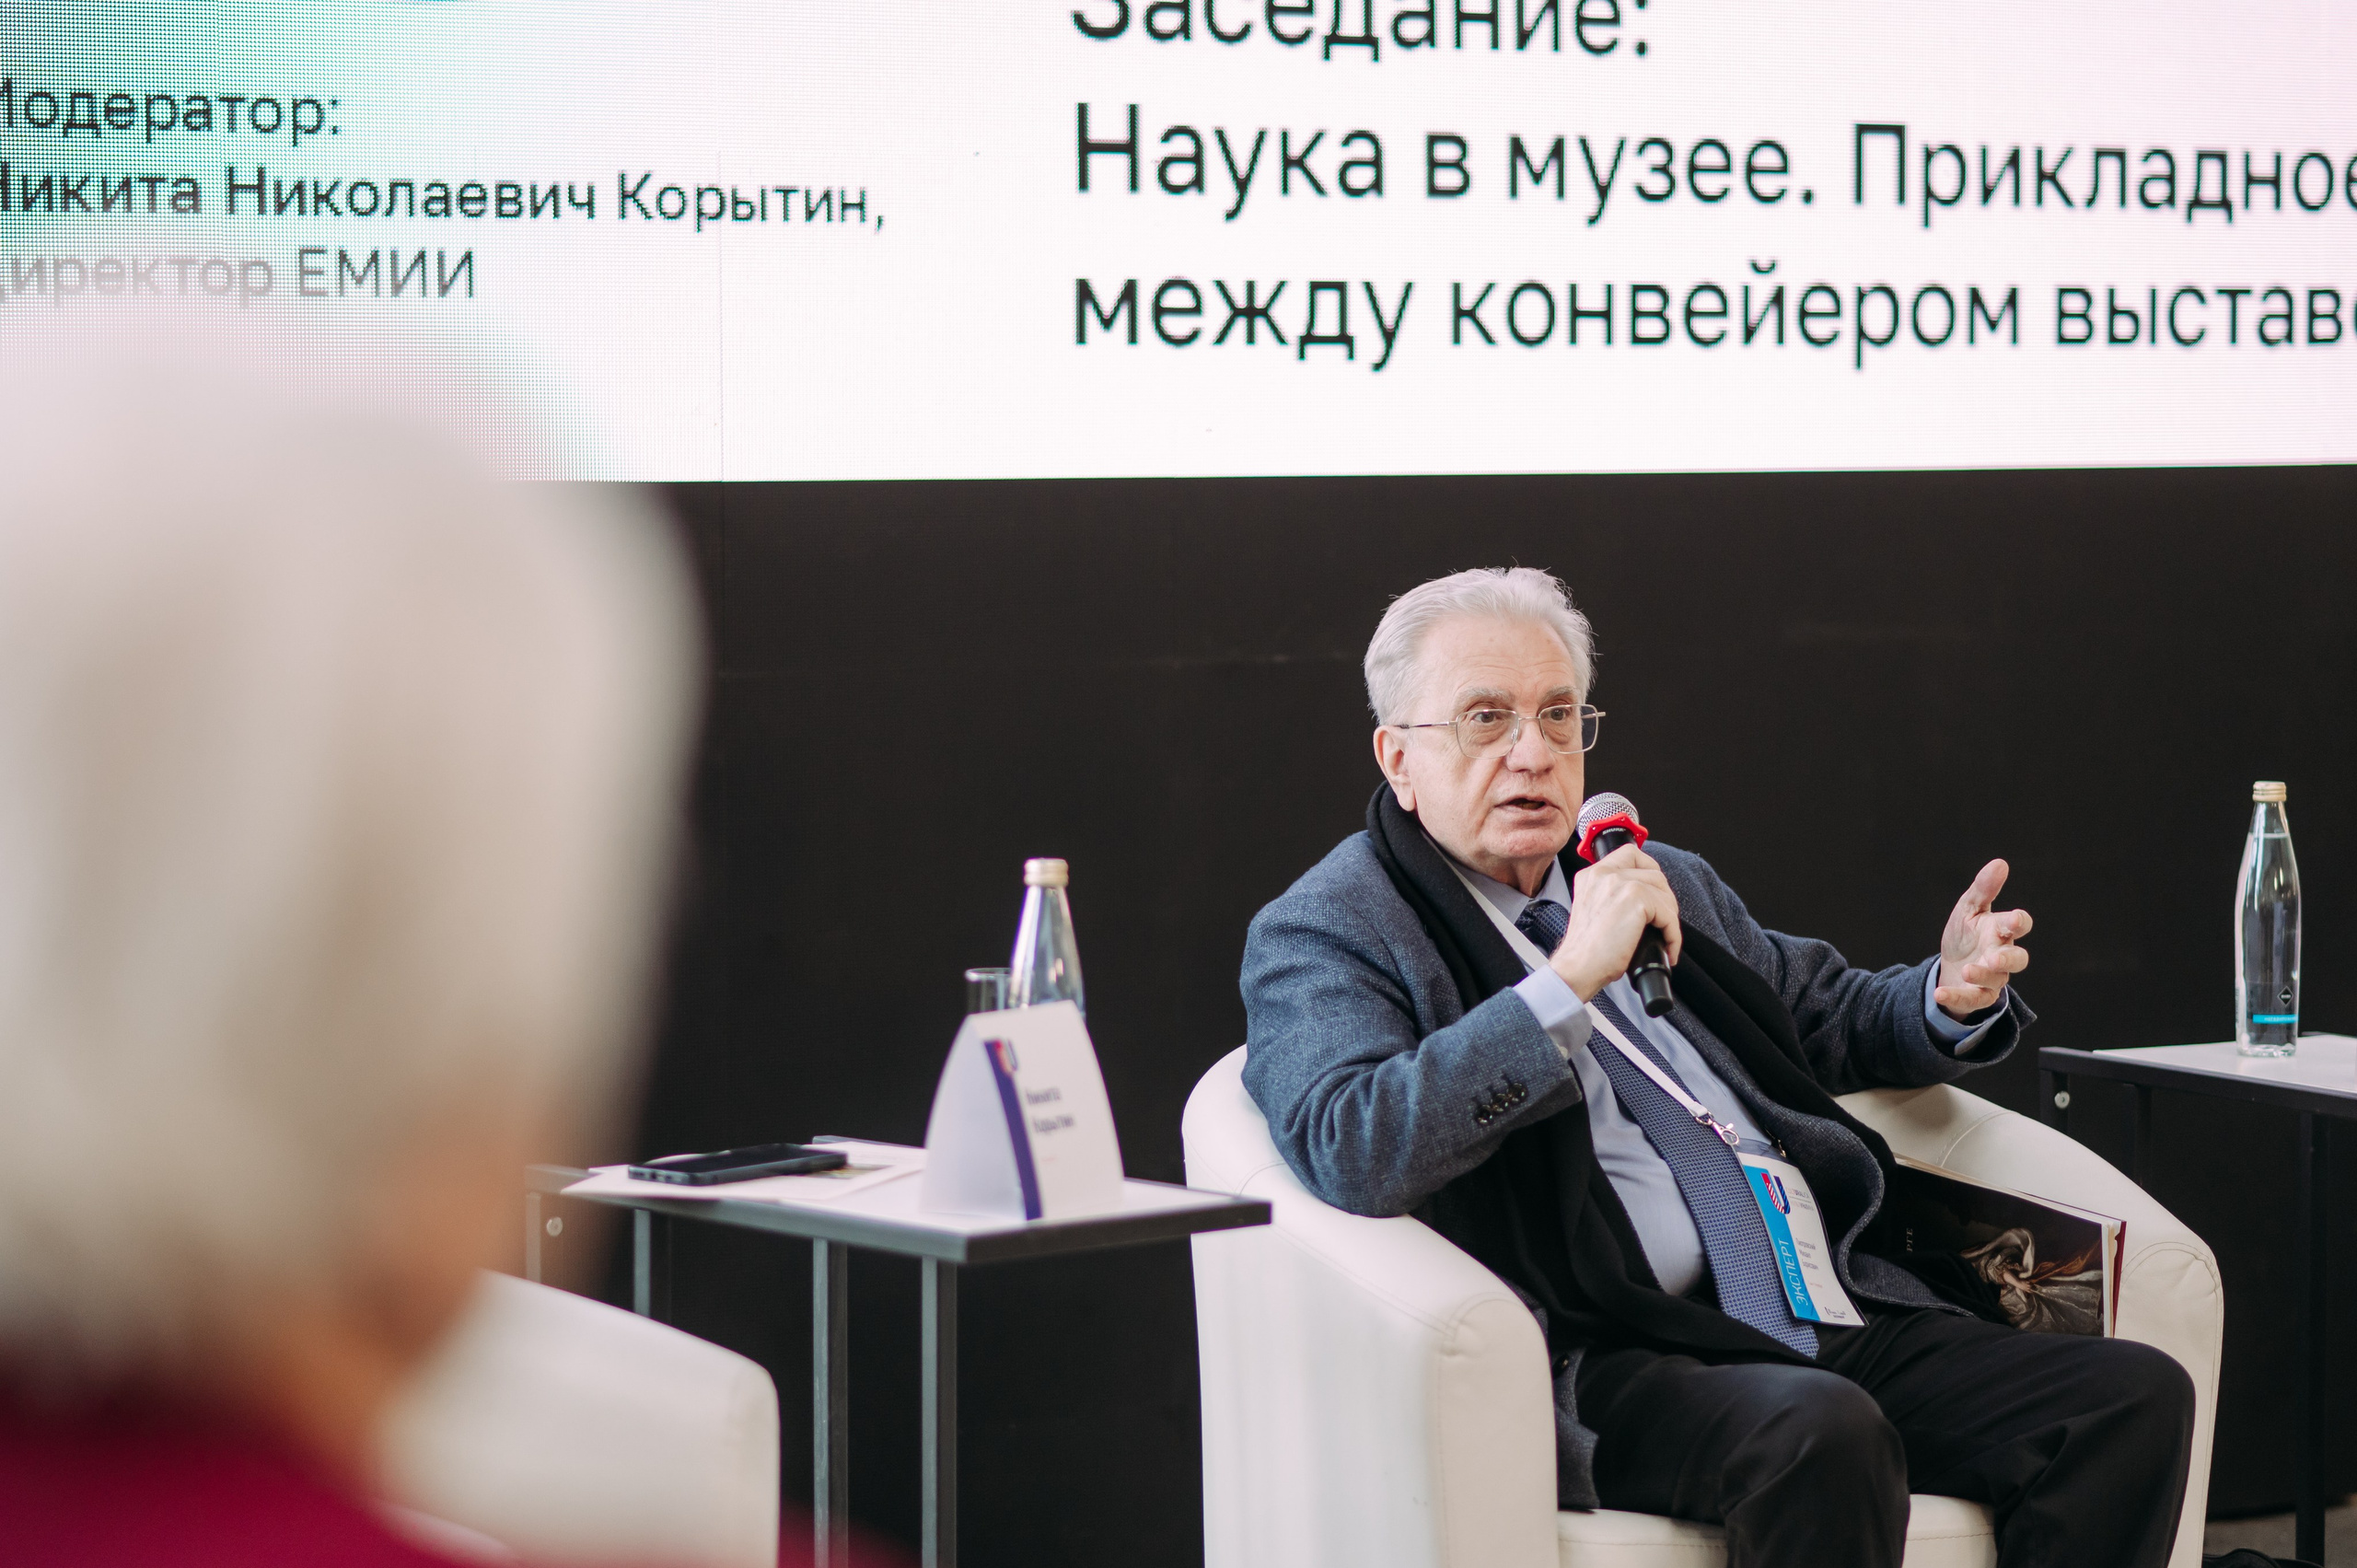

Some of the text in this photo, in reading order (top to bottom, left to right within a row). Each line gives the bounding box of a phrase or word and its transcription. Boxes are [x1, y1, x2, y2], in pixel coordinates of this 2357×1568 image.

[0, 162, 886, 232] икита Николаевич Корытин,
[1076, 102, 1384, 221] Наука
[1426, 132, 1470, 198] в
[1509, 135, 1814, 226] музее.
[0, 247, 475, 308] иректор ЕМИИ
[1075, 260, 2357, 372] между конвейером выстав
[1778, 1237, 1808, 1306] ЭКСПЕРТ
